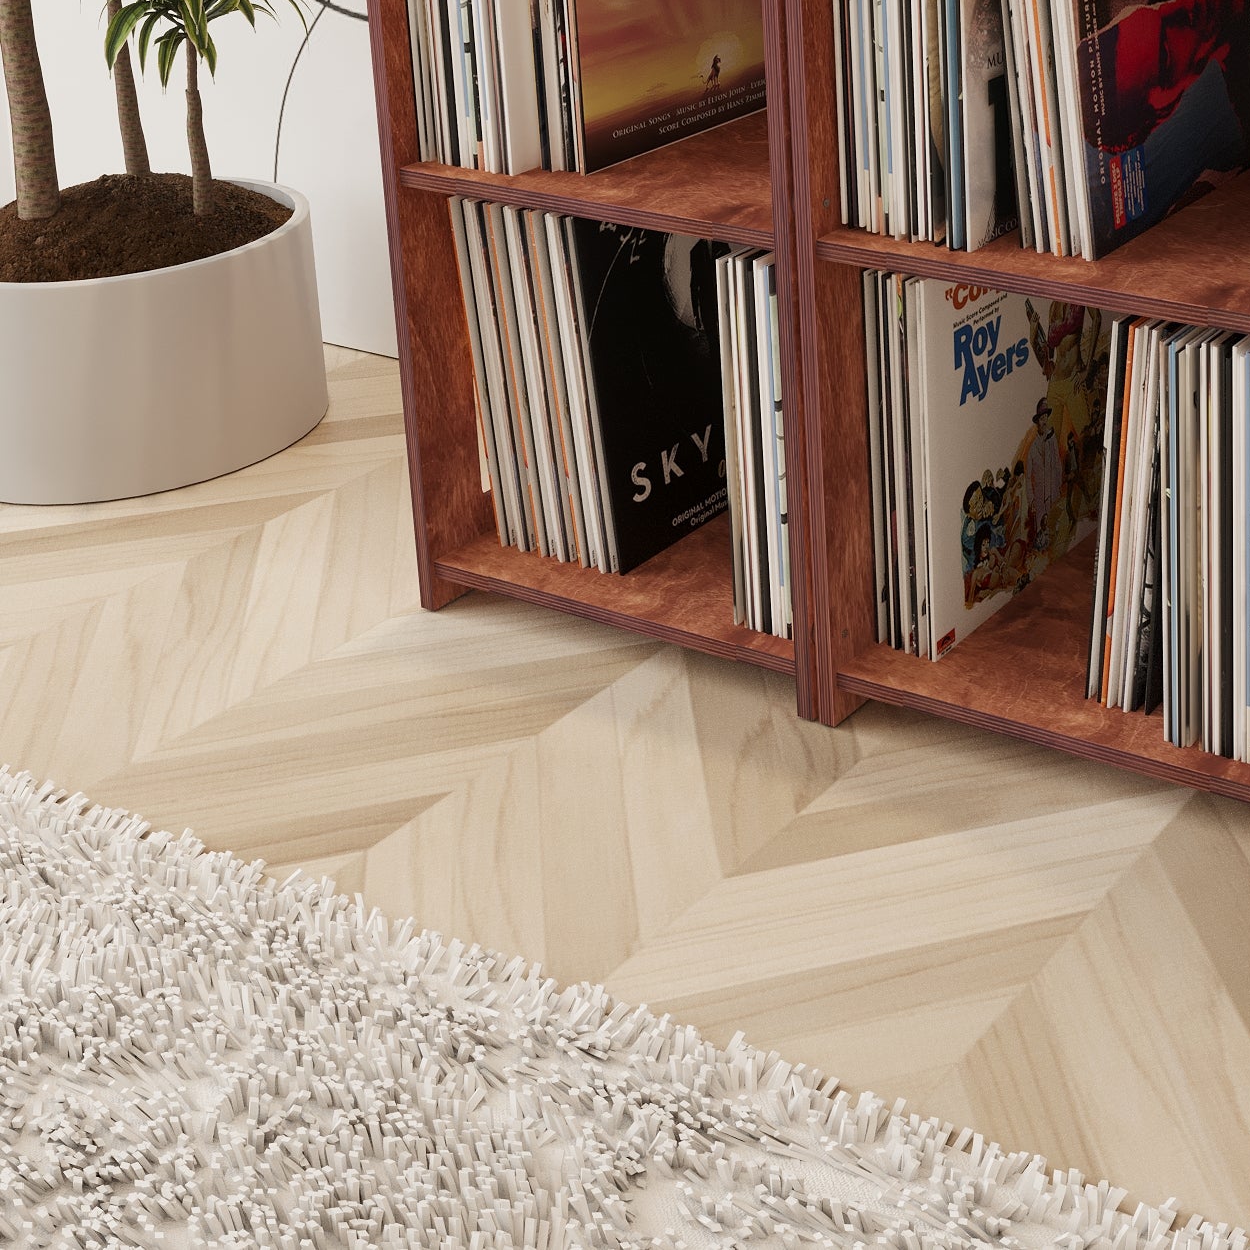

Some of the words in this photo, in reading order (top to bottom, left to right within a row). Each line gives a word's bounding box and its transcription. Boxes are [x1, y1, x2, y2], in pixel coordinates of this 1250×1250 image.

[1095, 51, 1103, 76] HANS
[1089, 60, 1099, 113] MOTION
[1097, 77, 1103, 89] BY
[612, 122, 647, 139] ORIGINAL
[648, 113, 671, 127] SONGS
[676, 102, 697, 116] MUSIC
[698, 99, 706, 108] BY
[707, 92, 728, 106] ELTON
[728, 86, 746, 99] JOHN
[658, 121, 680, 135] SCORE
[681, 108, 717, 127] COMPOSED
[718, 104, 726, 114] BY
[726, 97, 745, 111] HANS
[1096, 118, 1106, 185] ORIGINAL
[953, 318, 966, 329] Music
[966, 311, 978, 322] Score
[978, 298, 999, 314] Composed
[953, 315, 1002, 370] Roy
[959, 337, 1029, 406] Ayers
[672, 502, 705, 527] ORIGINAL
[690, 507, 715, 526] Original
